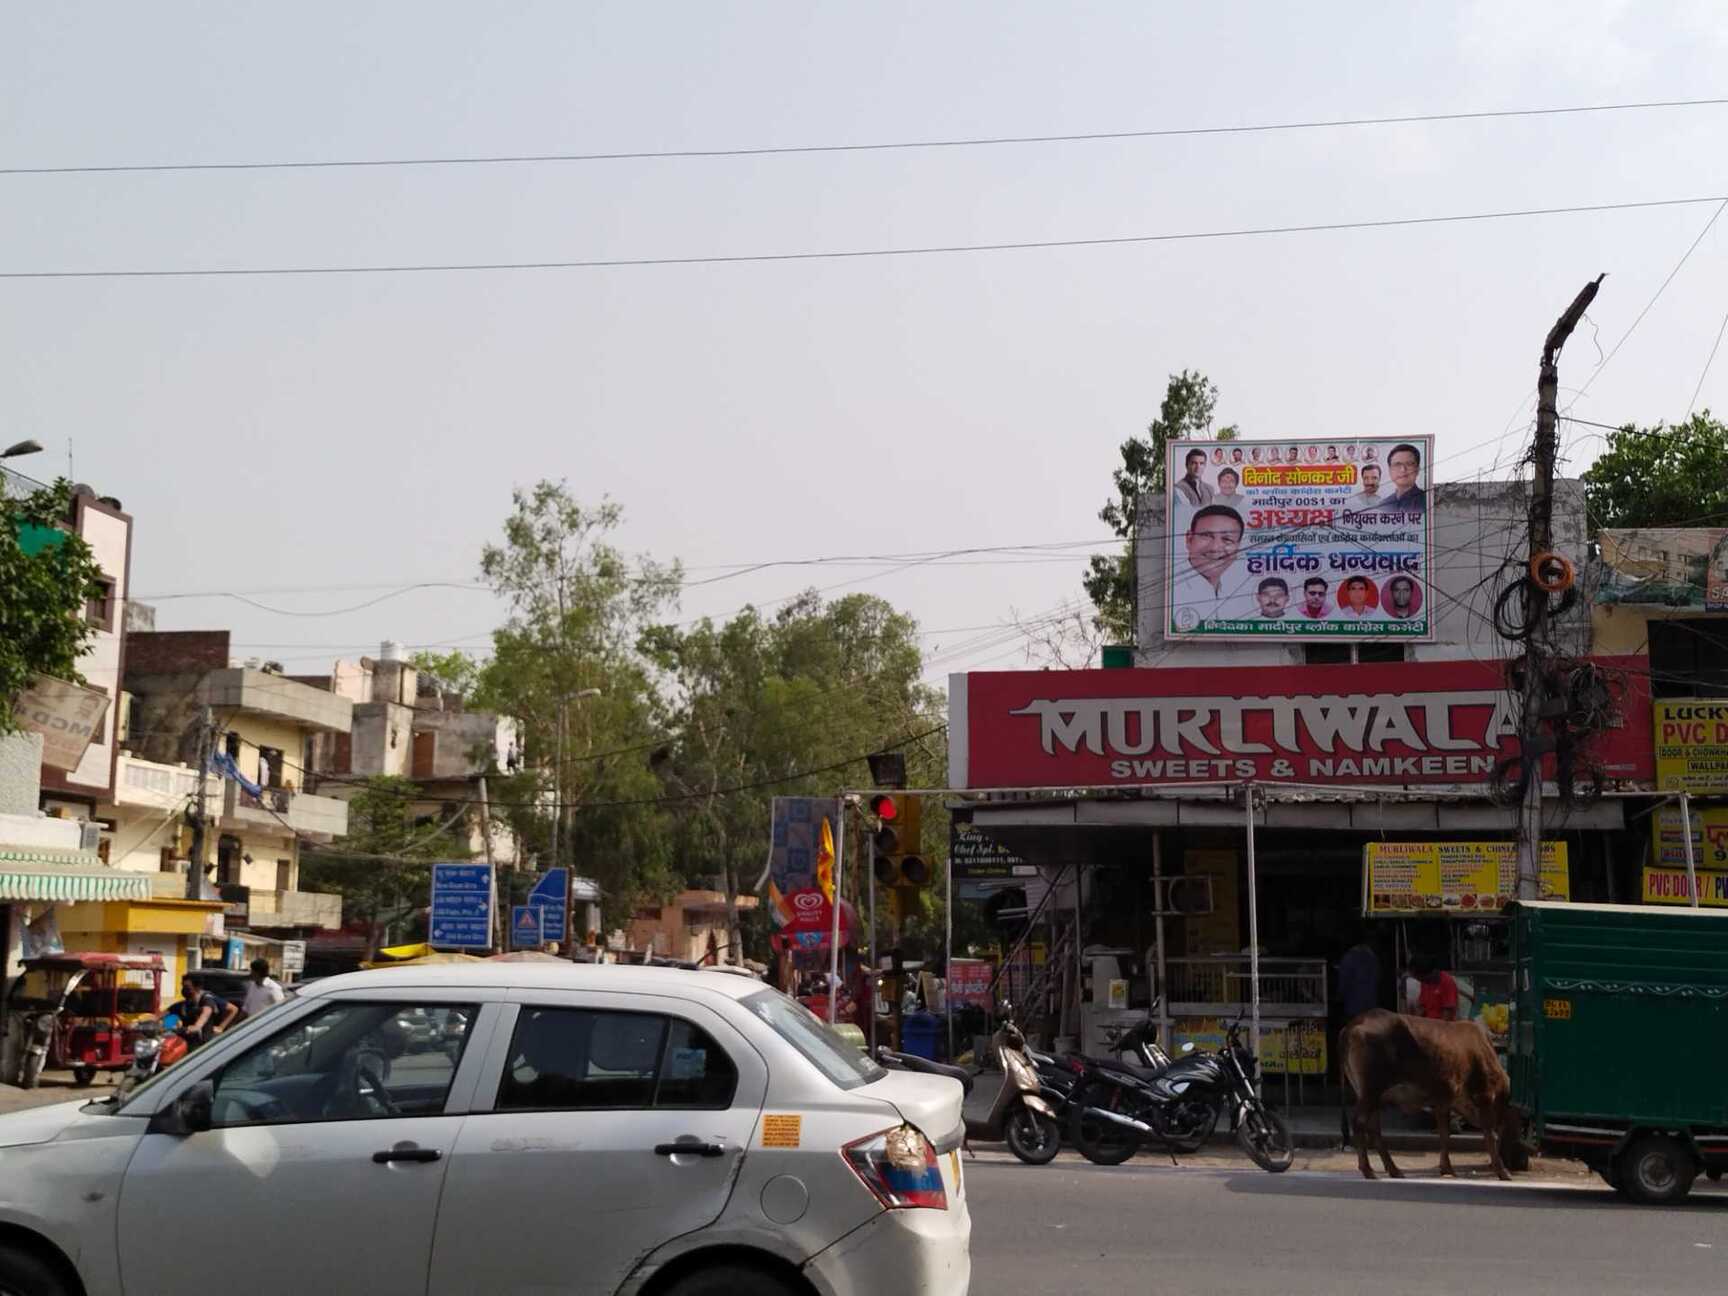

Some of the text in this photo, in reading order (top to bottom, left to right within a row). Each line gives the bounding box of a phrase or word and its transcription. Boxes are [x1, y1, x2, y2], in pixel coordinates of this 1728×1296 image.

[1244, 464, 1354, 485] विनोद सोनकर जी
[1251, 495, 1293, 508] मादीपुर
[1247, 509, 1421, 529] अध्यक्ष नियुक्त करने पर
[1246, 543, 1421, 574] हार्दिक धन्यवाद
[1009, 690, 1524, 756] MURLIWALA
[1663, 723, 1706, 745] PVC
[1110, 755, 1495, 778] SWEETS & NAMKEEN
[1648, 873, 1670, 896] PVC
[1673, 874, 1703, 897] DOR
